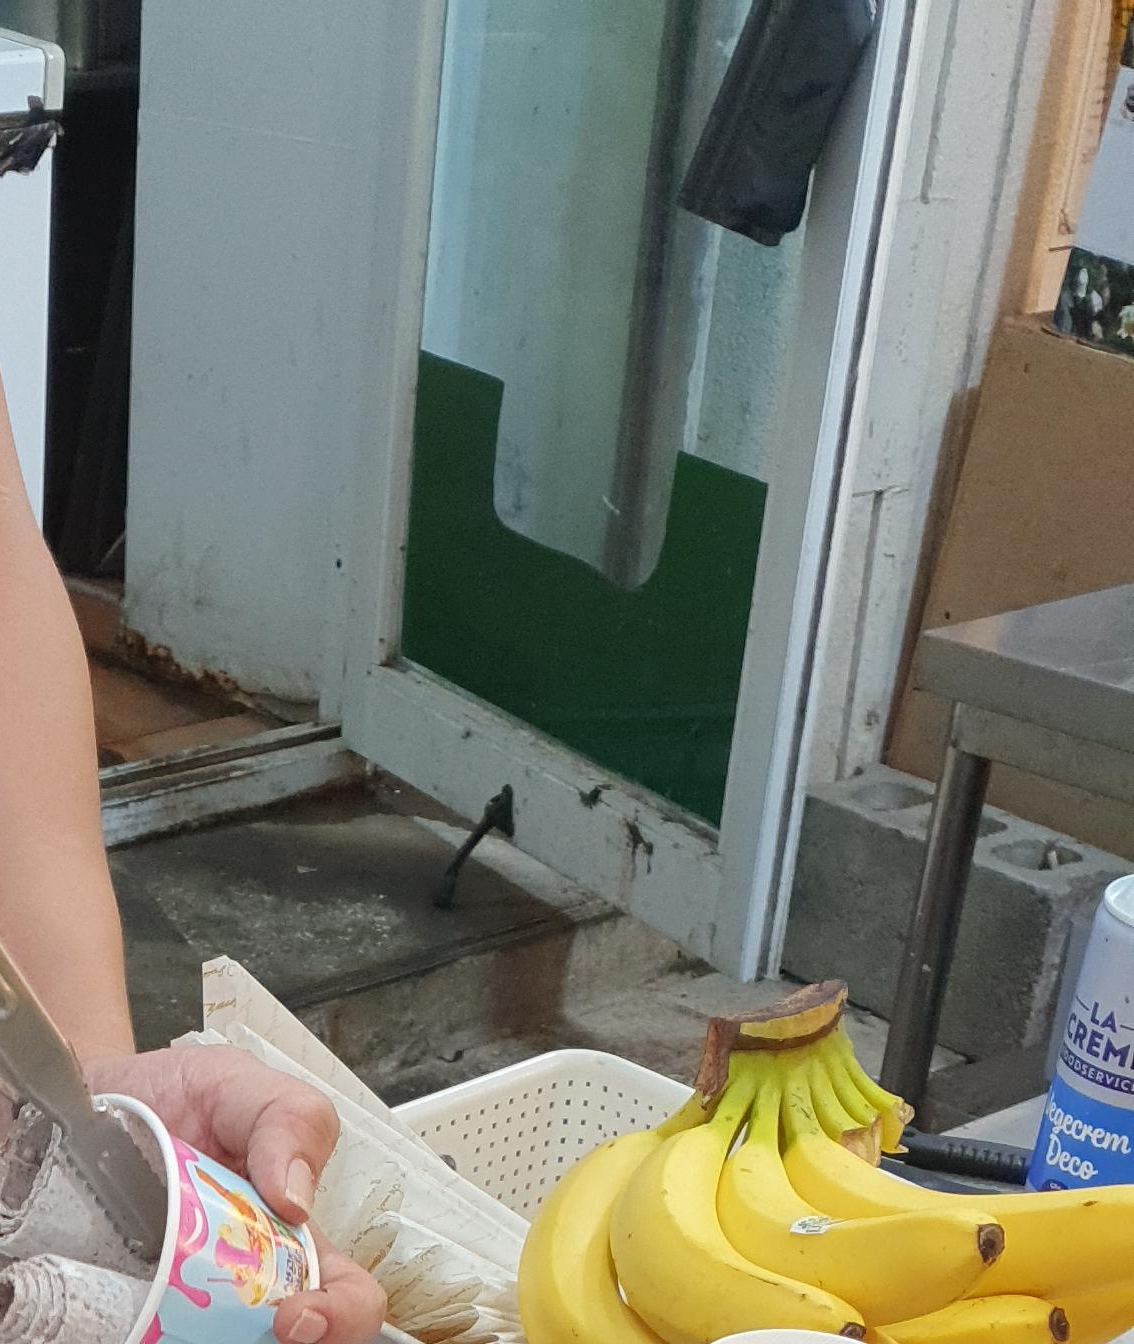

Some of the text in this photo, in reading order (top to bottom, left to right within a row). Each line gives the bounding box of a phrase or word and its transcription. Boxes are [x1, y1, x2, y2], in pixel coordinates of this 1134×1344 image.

[1066, 1012, 1134, 1070] CREM
[1090, 1001, 1118, 1034] LA
[1045, 1133, 1098, 1181] Deco
